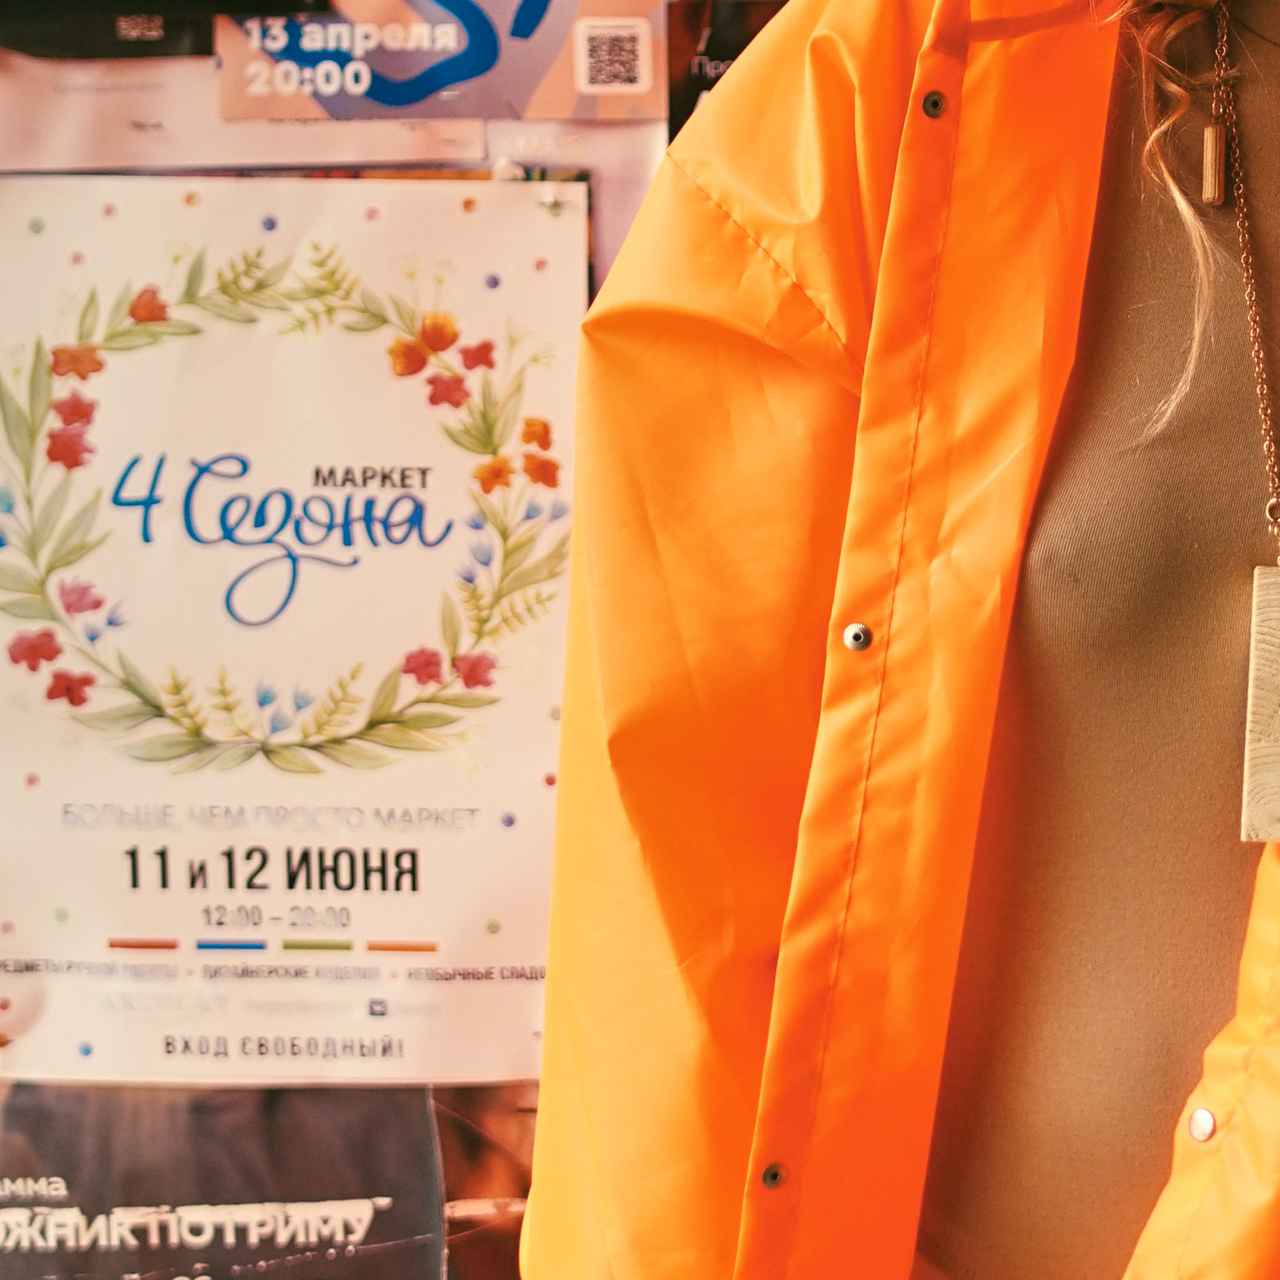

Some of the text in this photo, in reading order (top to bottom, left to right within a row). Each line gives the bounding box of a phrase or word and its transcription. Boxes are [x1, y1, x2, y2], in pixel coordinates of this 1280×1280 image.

[245, 18, 458, 54] 13 апреля
[244, 60, 373, 96] 20:00
[313, 465, 431, 490] МАРКЕТ
[111, 451, 455, 626] 4 Сезона
[185, 804, 246, 832] ЧЕМ
[252, 806, 366, 833] ПРОСТО
[373, 807, 481, 833] МАРКЕТ
[124, 845, 420, 892] 11 и 12 ИЮНЯ
[201, 905, 352, 928] 12:00 20:00
[407, 965, 496, 982] НЕОБЫЧНЫЕ
[163, 1035, 405, 1060] ВХОД СВОБОДНЫЙ!
